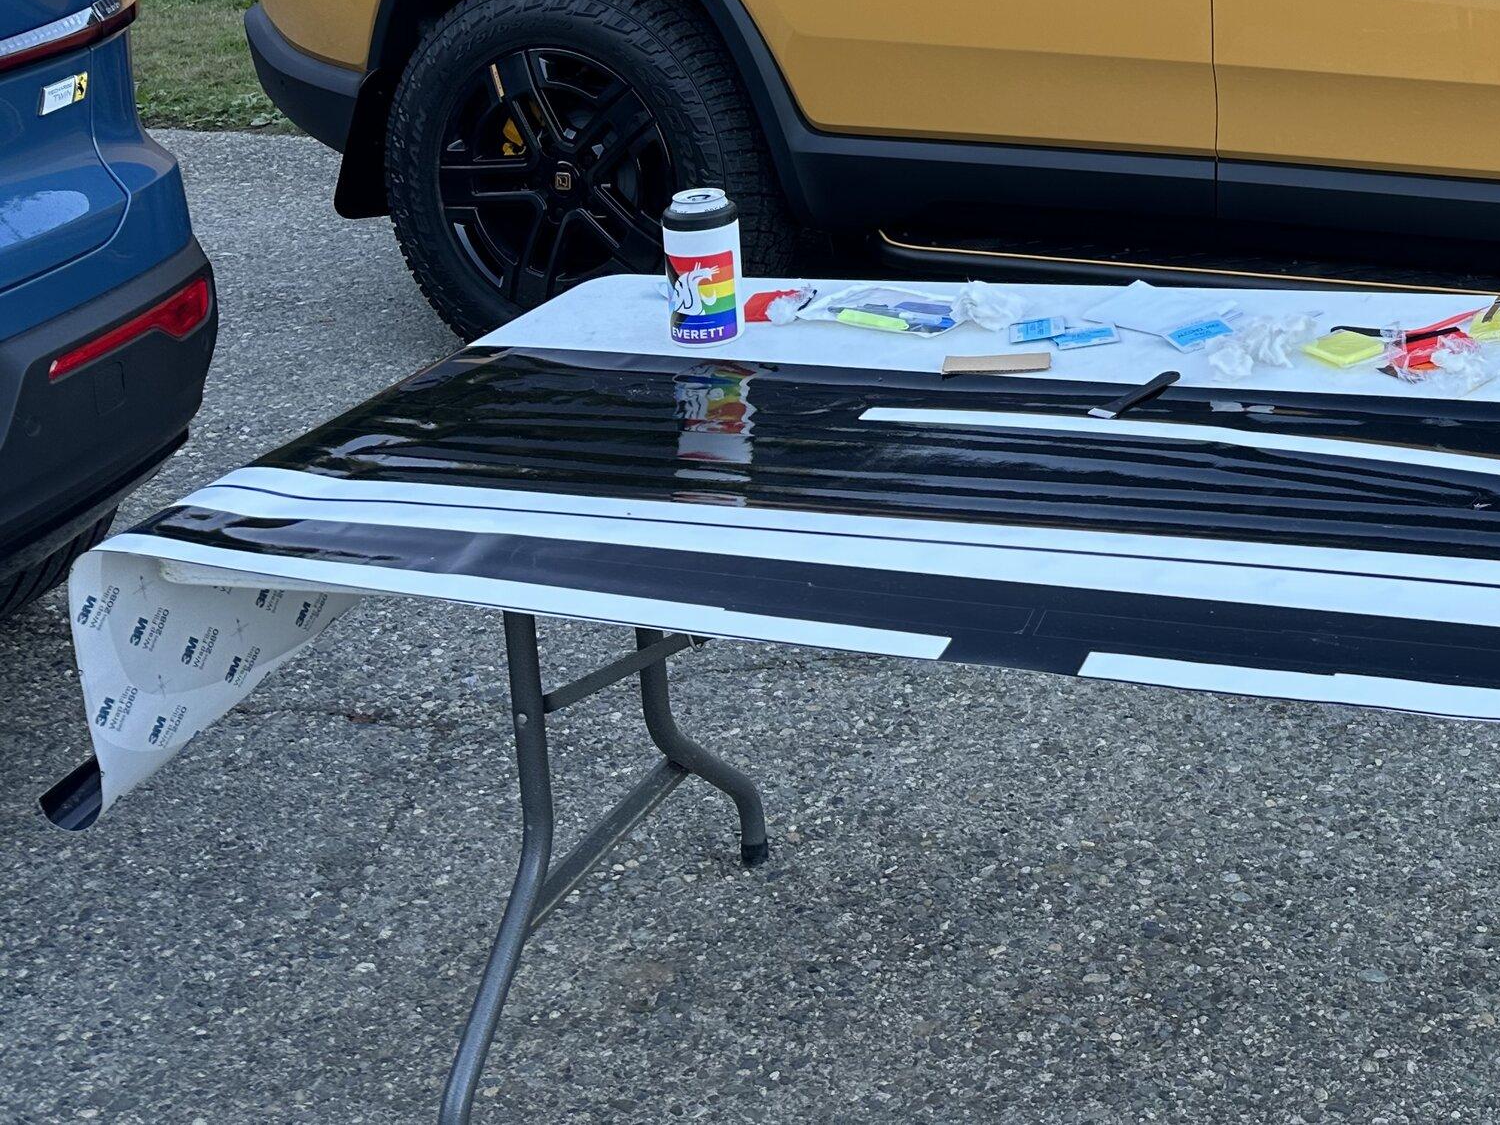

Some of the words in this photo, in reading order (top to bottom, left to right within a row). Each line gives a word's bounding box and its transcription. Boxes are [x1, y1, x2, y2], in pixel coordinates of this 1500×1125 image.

[672, 326, 725, 340] EVERETT
[77, 595, 97, 625] 3M
[104, 587, 120, 615] 2080
[295, 601, 311, 627] 3M
[129, 616, 148, 646] 3M
[155, 609, 169, 636] 2080
[181, 636, 199, 665] 3M
[205, 628, 219, 655] 2080
[225, 655, 242, 684] 3M
[95, 696, 115, 727] 3M
[124, 687, 138, 715] 2080
[148, 715, 167, 745] 3M
